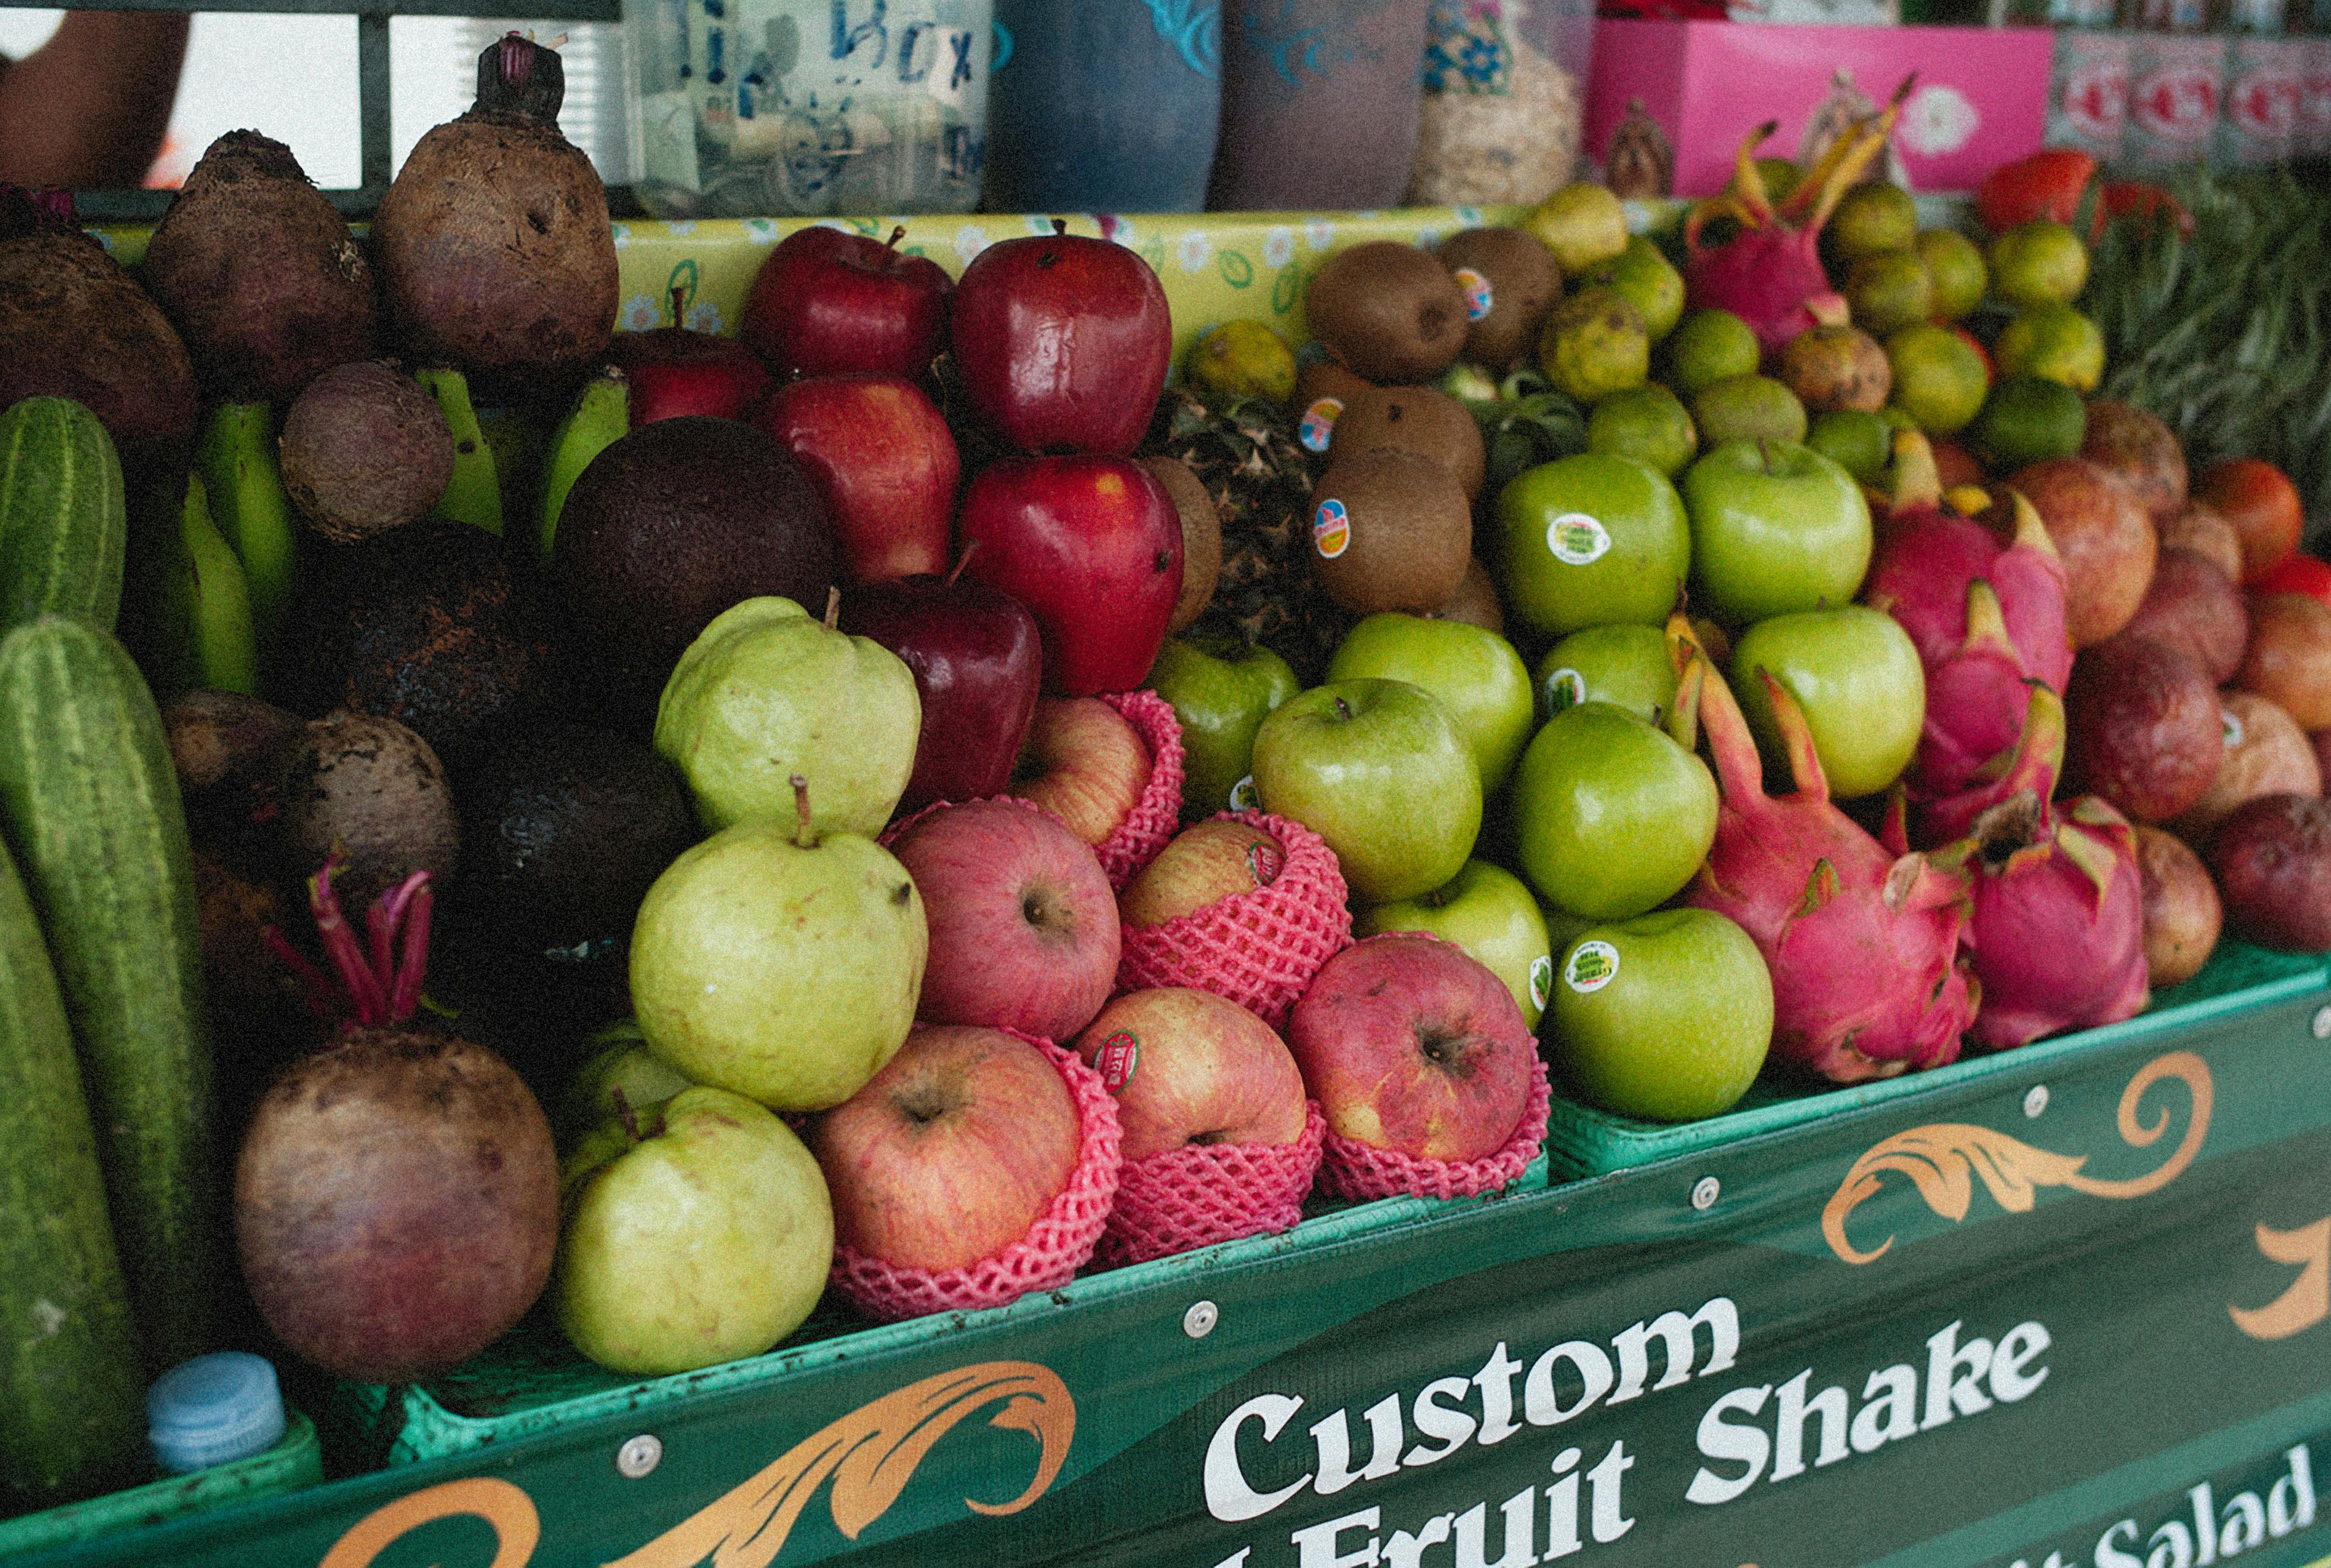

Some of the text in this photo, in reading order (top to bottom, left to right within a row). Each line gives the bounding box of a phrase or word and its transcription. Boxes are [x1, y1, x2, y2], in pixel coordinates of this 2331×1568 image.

[1204, 1298, 1740, 1521] Custom
[1291, 1320, 2051, 1568] Fruit Shake
[2094, 1443, 2316, 1568] Salad
